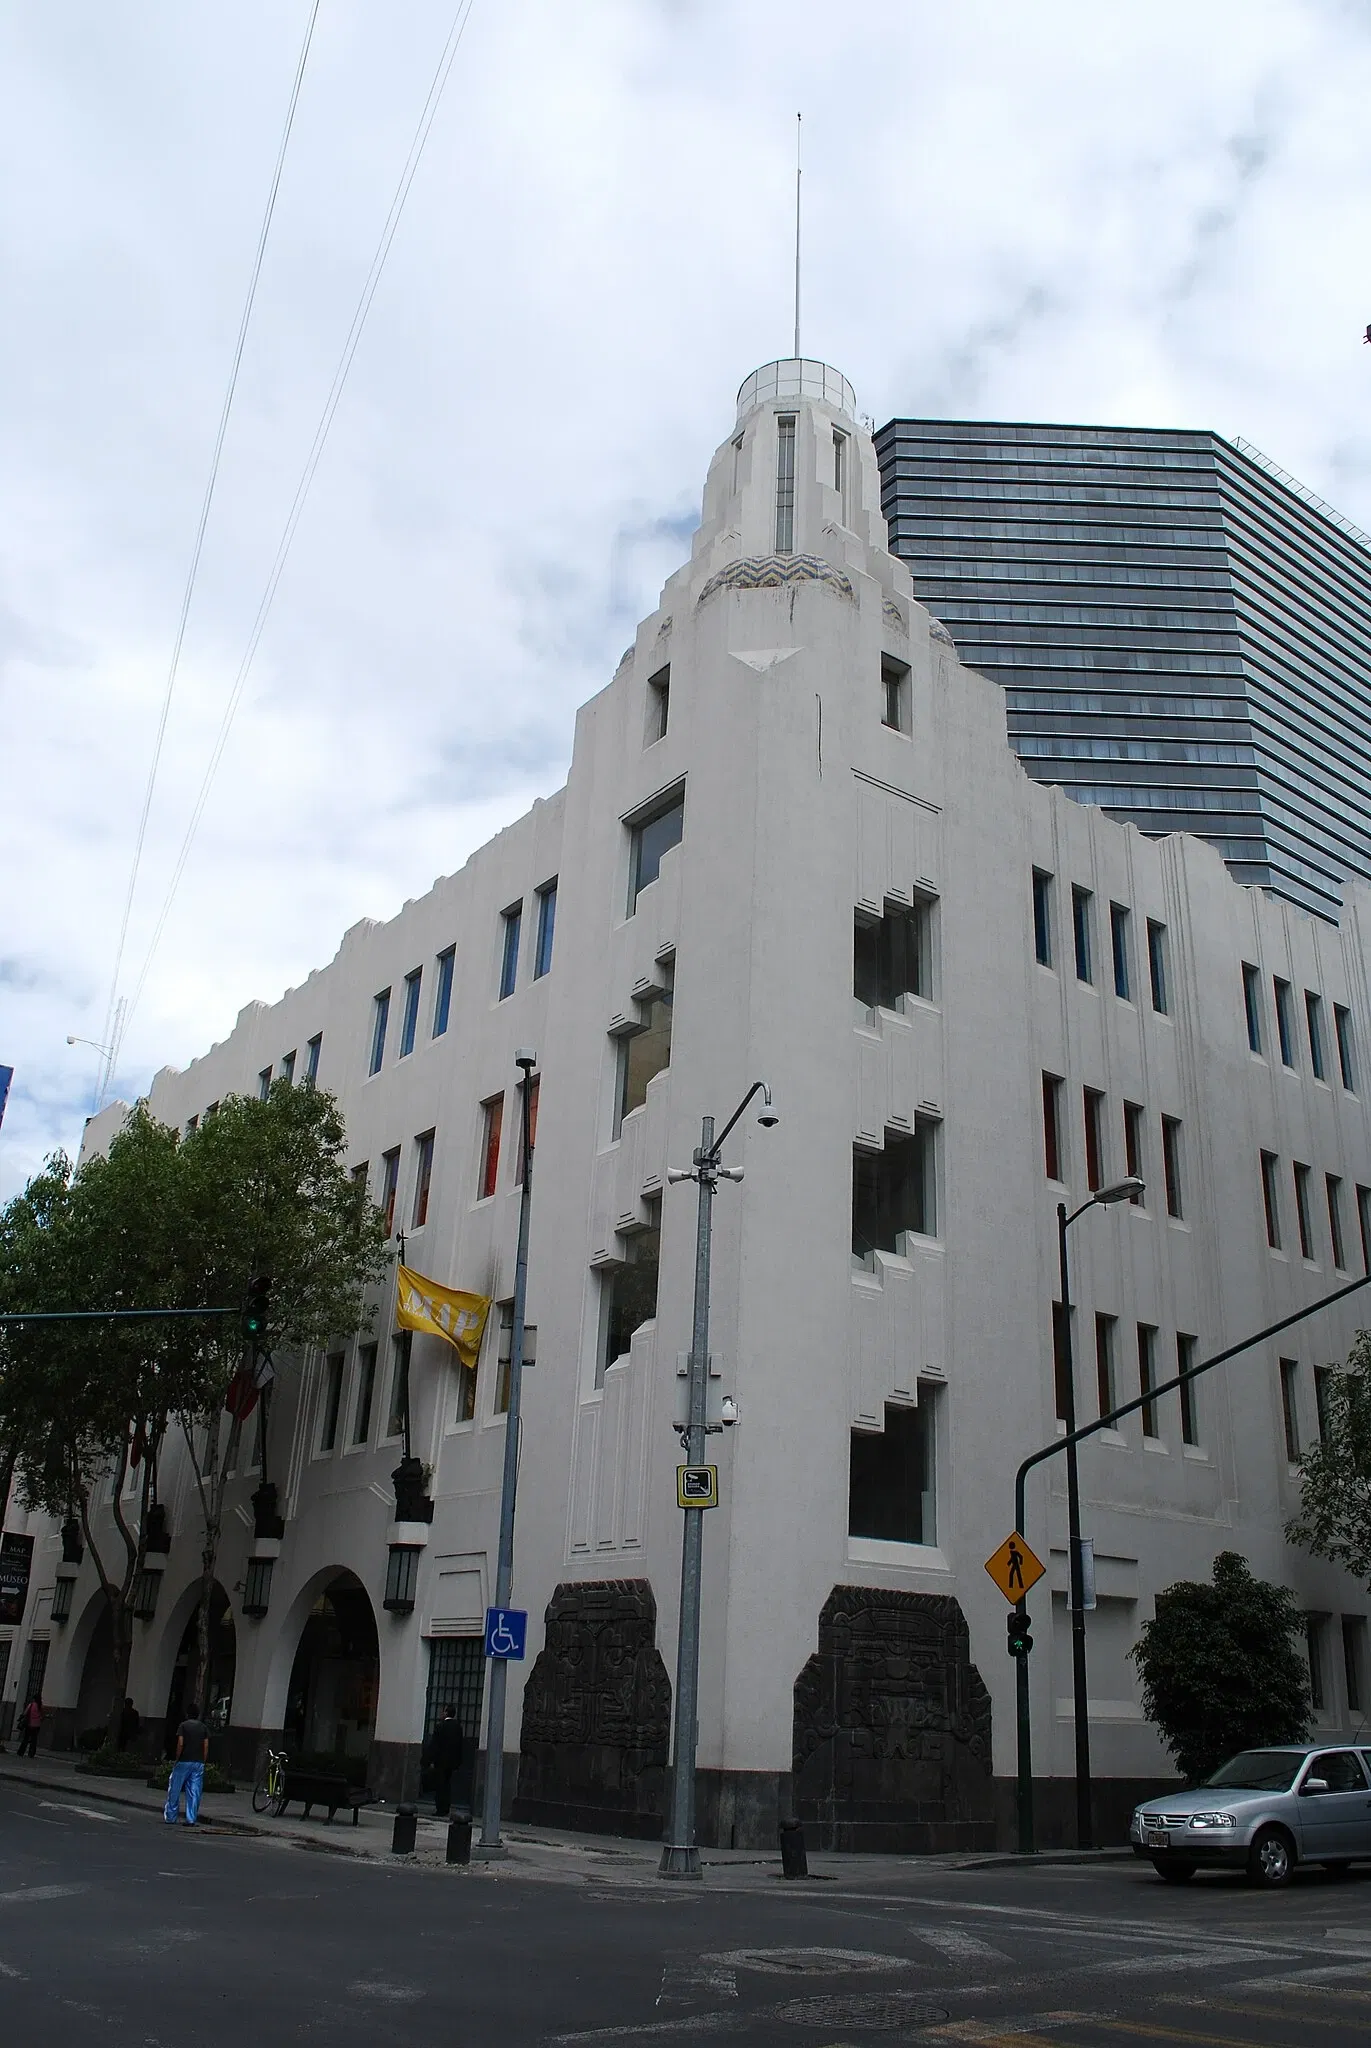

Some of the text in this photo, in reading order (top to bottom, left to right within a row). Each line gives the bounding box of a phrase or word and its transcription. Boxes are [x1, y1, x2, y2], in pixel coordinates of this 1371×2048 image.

[406, 1286, 479, 1338] MAP
[9, 1546, 26, 1554] MAP
[0, 1574, 28, 1585] MUSEO
